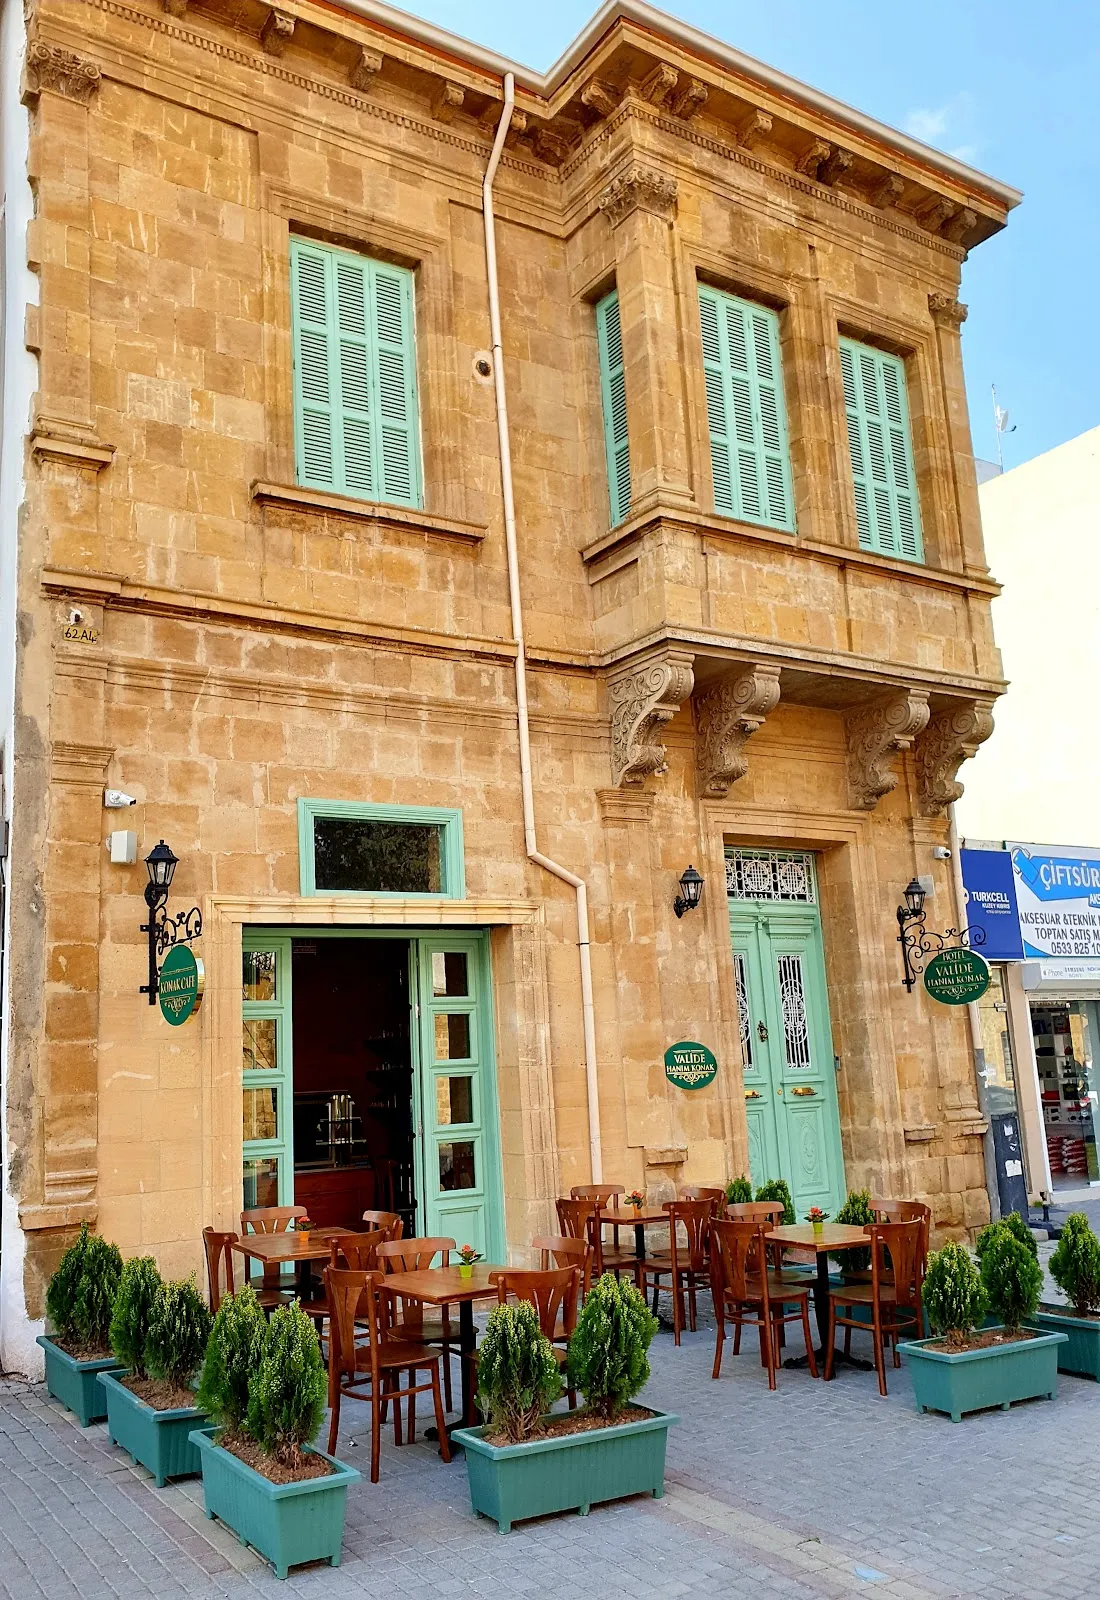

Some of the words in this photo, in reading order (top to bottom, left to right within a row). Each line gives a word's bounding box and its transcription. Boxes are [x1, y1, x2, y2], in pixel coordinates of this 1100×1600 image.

[1040, 859, 1100, 890] ÇİFTSÜR
[971, 891, 1009, 903] TURKCELL
[1020, 912, 1061, 924] AKSESUAR
[1035, 928, 1067, 939] TOPTAN
[1070, 929, 1091, 943] SATIŞ
[1051, 941, 1072, 954] 0533
[1074, 942, 1089, 954] 825
[943, 951, 965, 961] HOTEL
[936, 963, 973, 976] VALİDE
[160, 978, 180, 994] KONAK
[181, 975, 195, 990] CAFE
[928, 977, 955, 987] HANIM
[957, 973, 985, 984] KONAK
[666, 1065, 690, 1073] HANIM
[691, 1064, 714, 1072] KONAK
